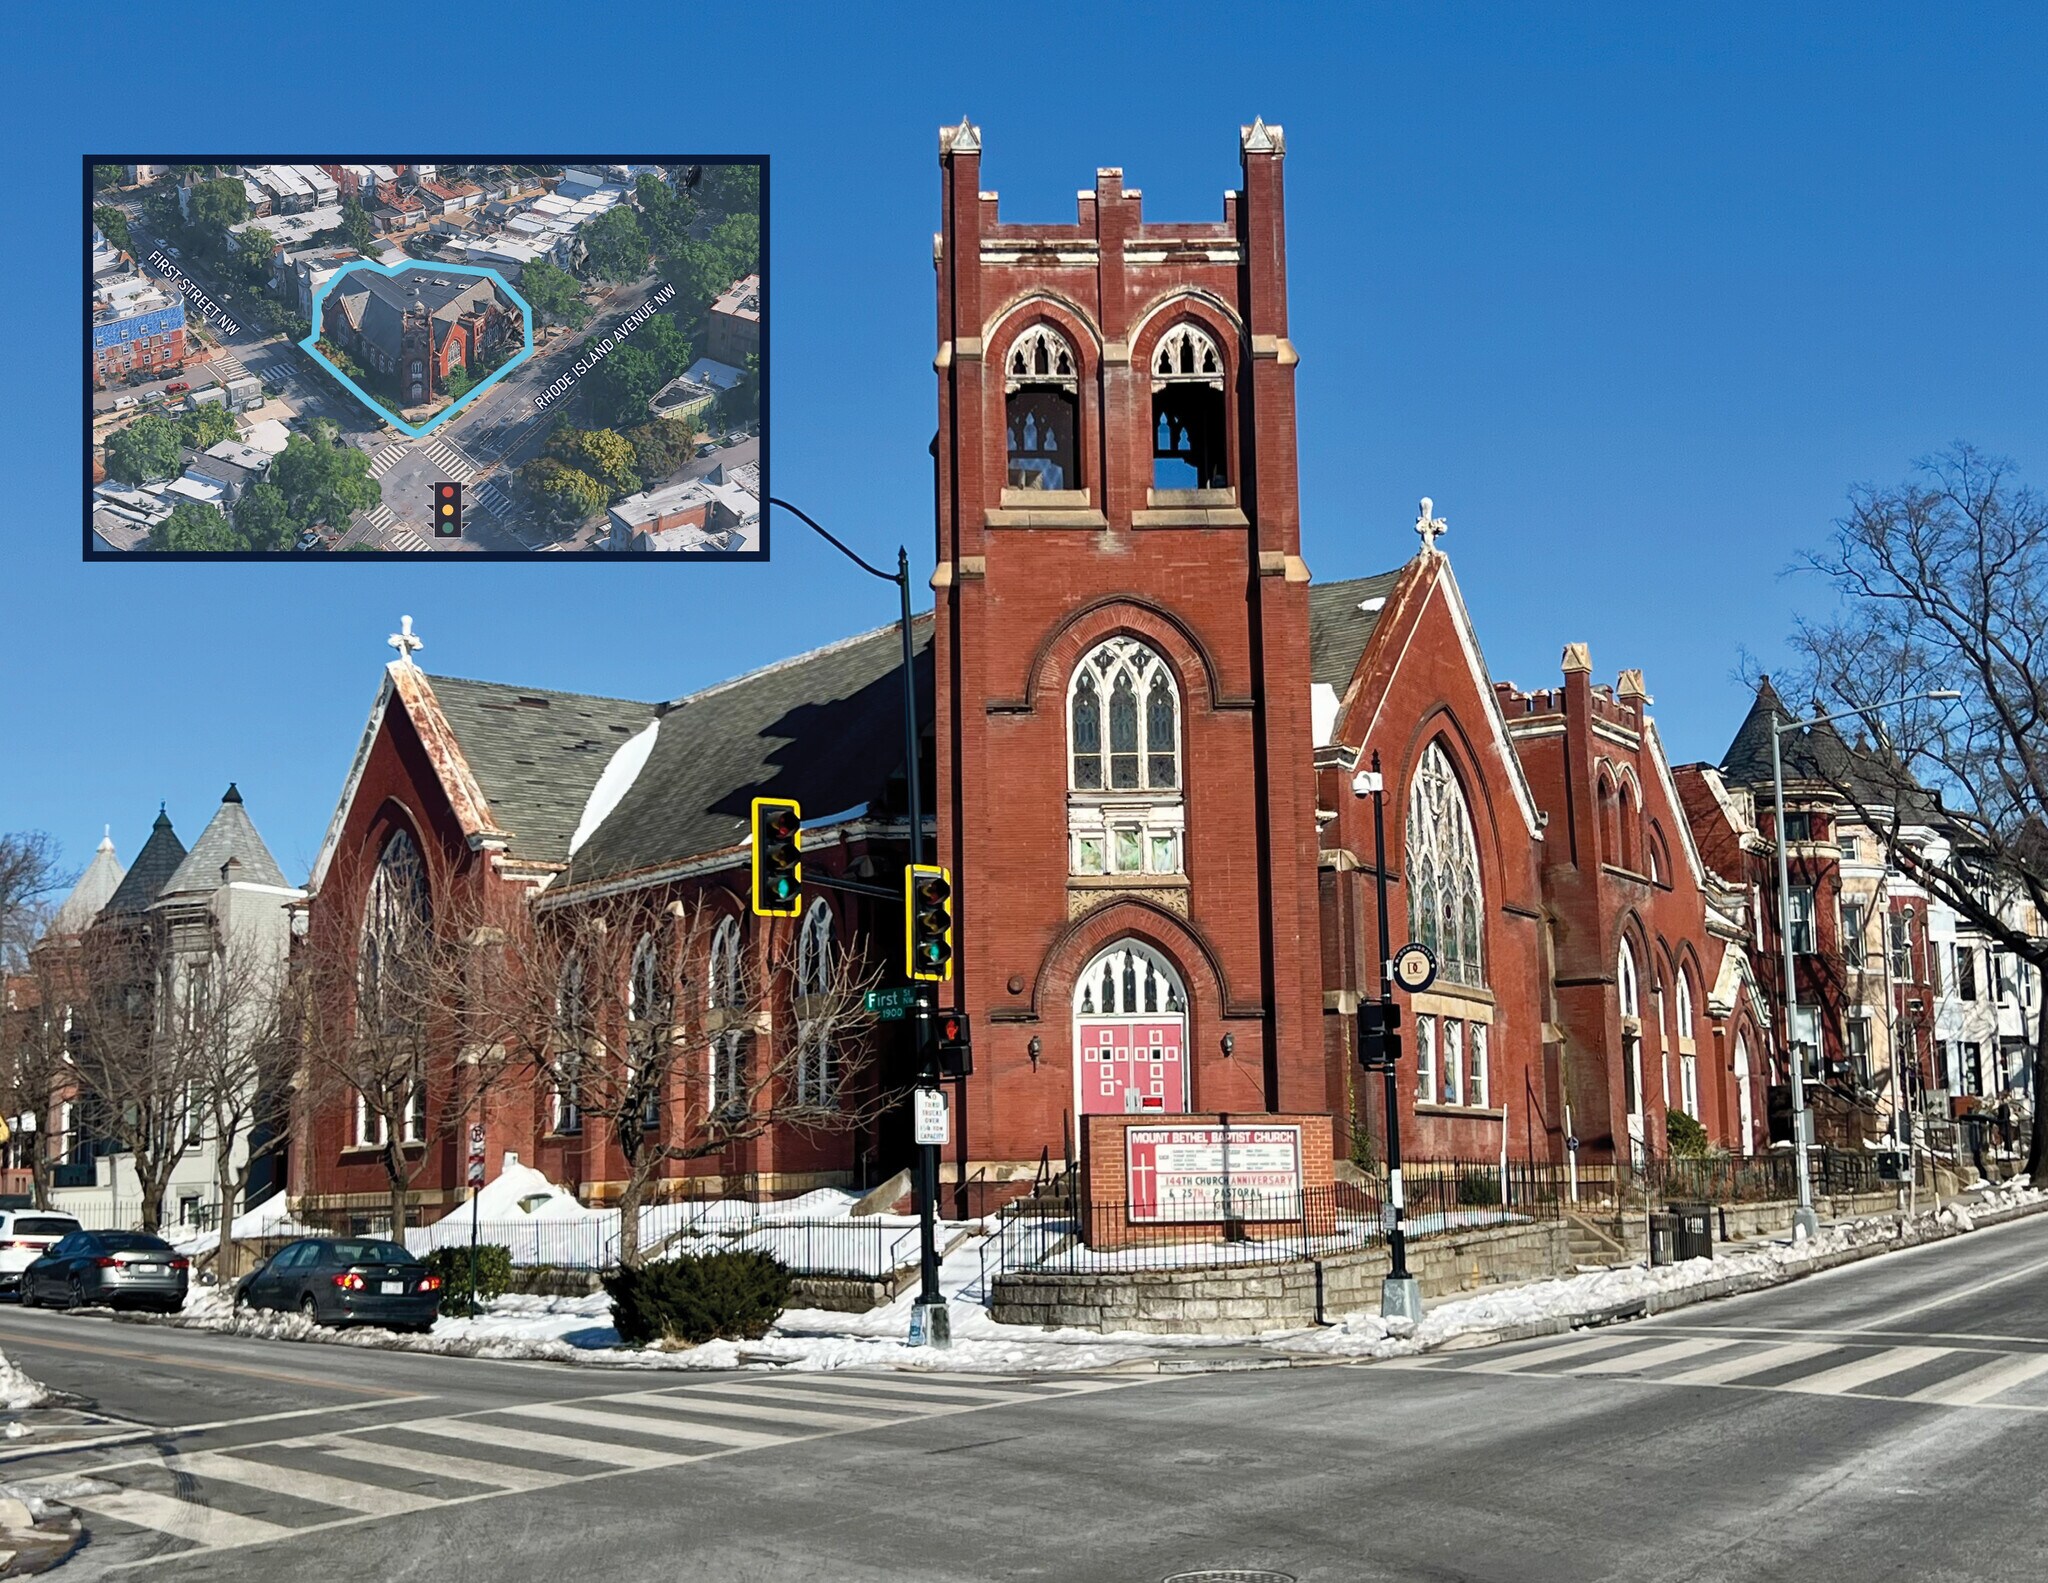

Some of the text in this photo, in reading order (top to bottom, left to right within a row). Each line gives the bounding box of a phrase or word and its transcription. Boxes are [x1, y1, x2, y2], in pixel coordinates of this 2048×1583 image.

[868, 989, 911, 1008] First St
[882, 1008, 903, 1018] 1900
[1132, 1131, 1294, 1144] MOUNT BETHEL BAPTIST CHURCH
[1165, 1175, 1293, 1186] 144TH CHURCH ANNIVERSARY
[1214, 1187, 1261, 1198] PASTORAL
